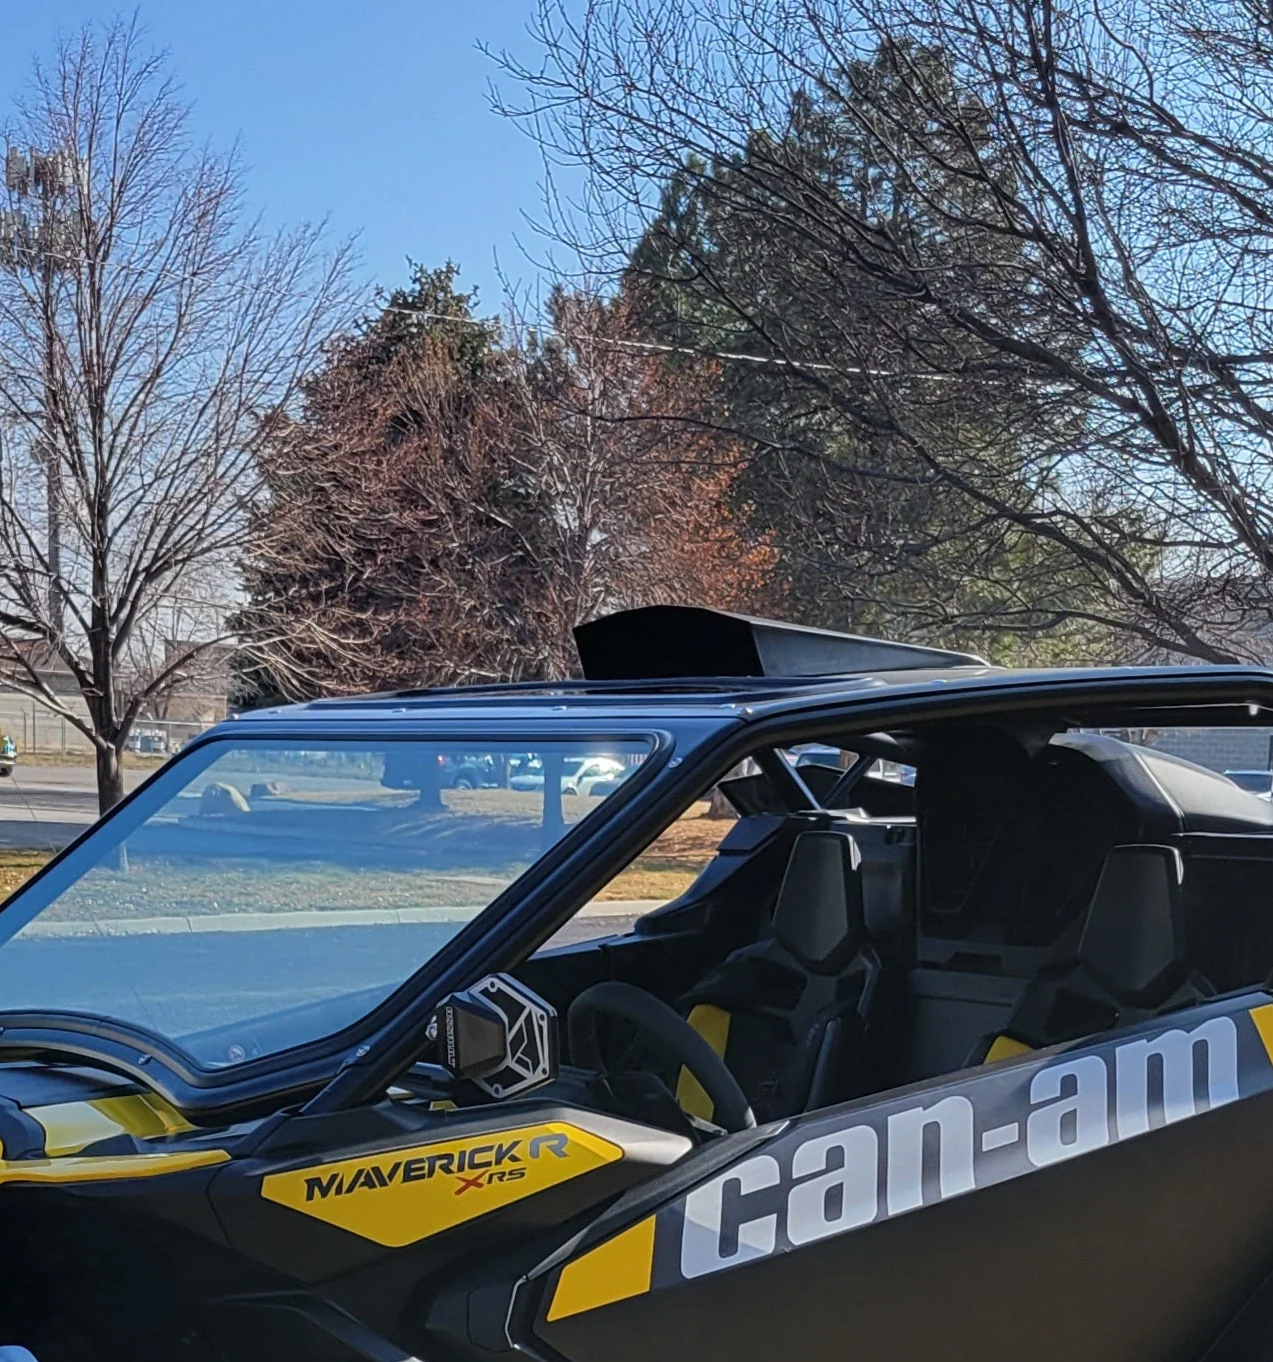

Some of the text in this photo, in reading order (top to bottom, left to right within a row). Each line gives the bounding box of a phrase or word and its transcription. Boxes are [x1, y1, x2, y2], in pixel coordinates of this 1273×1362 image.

[304, 1134, 569, 1200] MAVERICK R
[681, 1017, 1238, 1278] can-am
